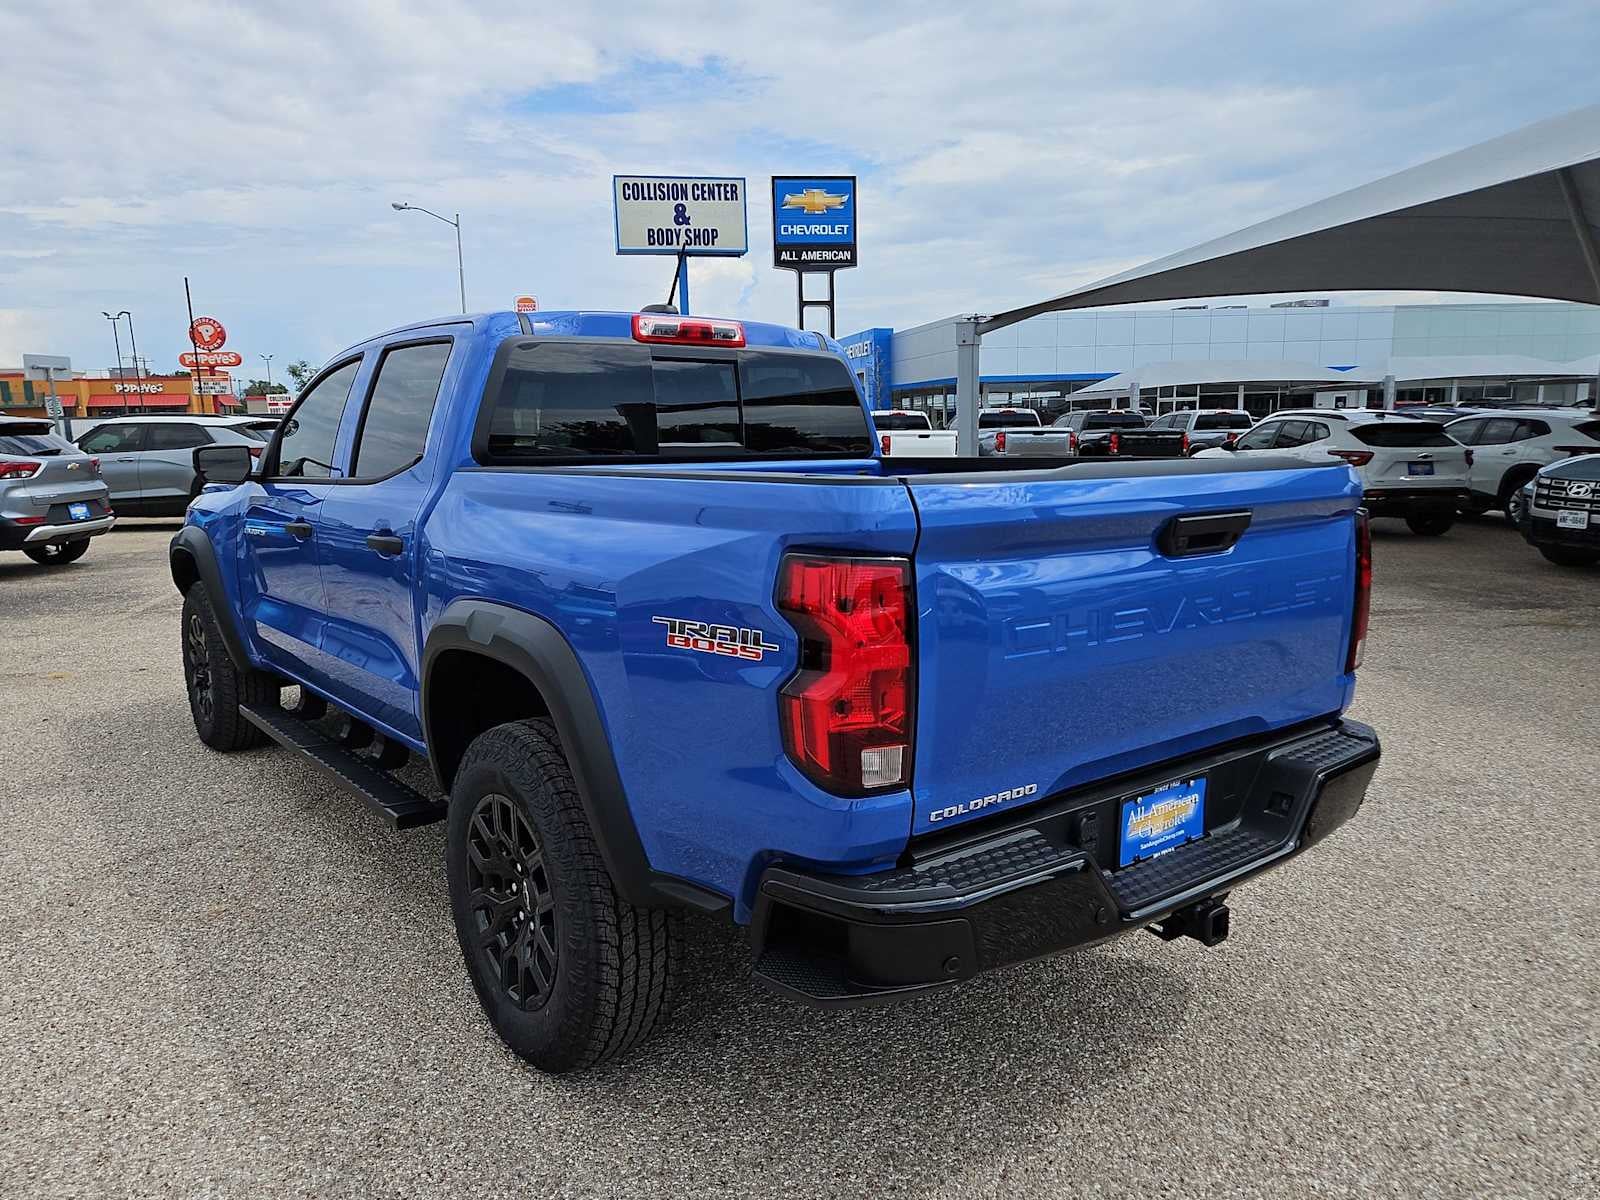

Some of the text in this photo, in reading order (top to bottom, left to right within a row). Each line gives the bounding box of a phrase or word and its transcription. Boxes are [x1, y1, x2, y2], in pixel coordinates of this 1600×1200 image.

[622, 182, 738, 201] COLLISION CENTER
[673, 203, 691, 226] &
[647, 228, 719, 246] BODY SHOP
[780, 224, 850, 236] CHEVROLET
[780, 250, 851, 261] ALL AMERICAN
[1002, 574, 1344, 661] CHEVROLET
[652, 615, 780, 652] TRAIL
[667, 632, 763, 662] BOSS
[929, 783, 1038, 822] COLORADO
[1127, 793, 1199, 826] All American
